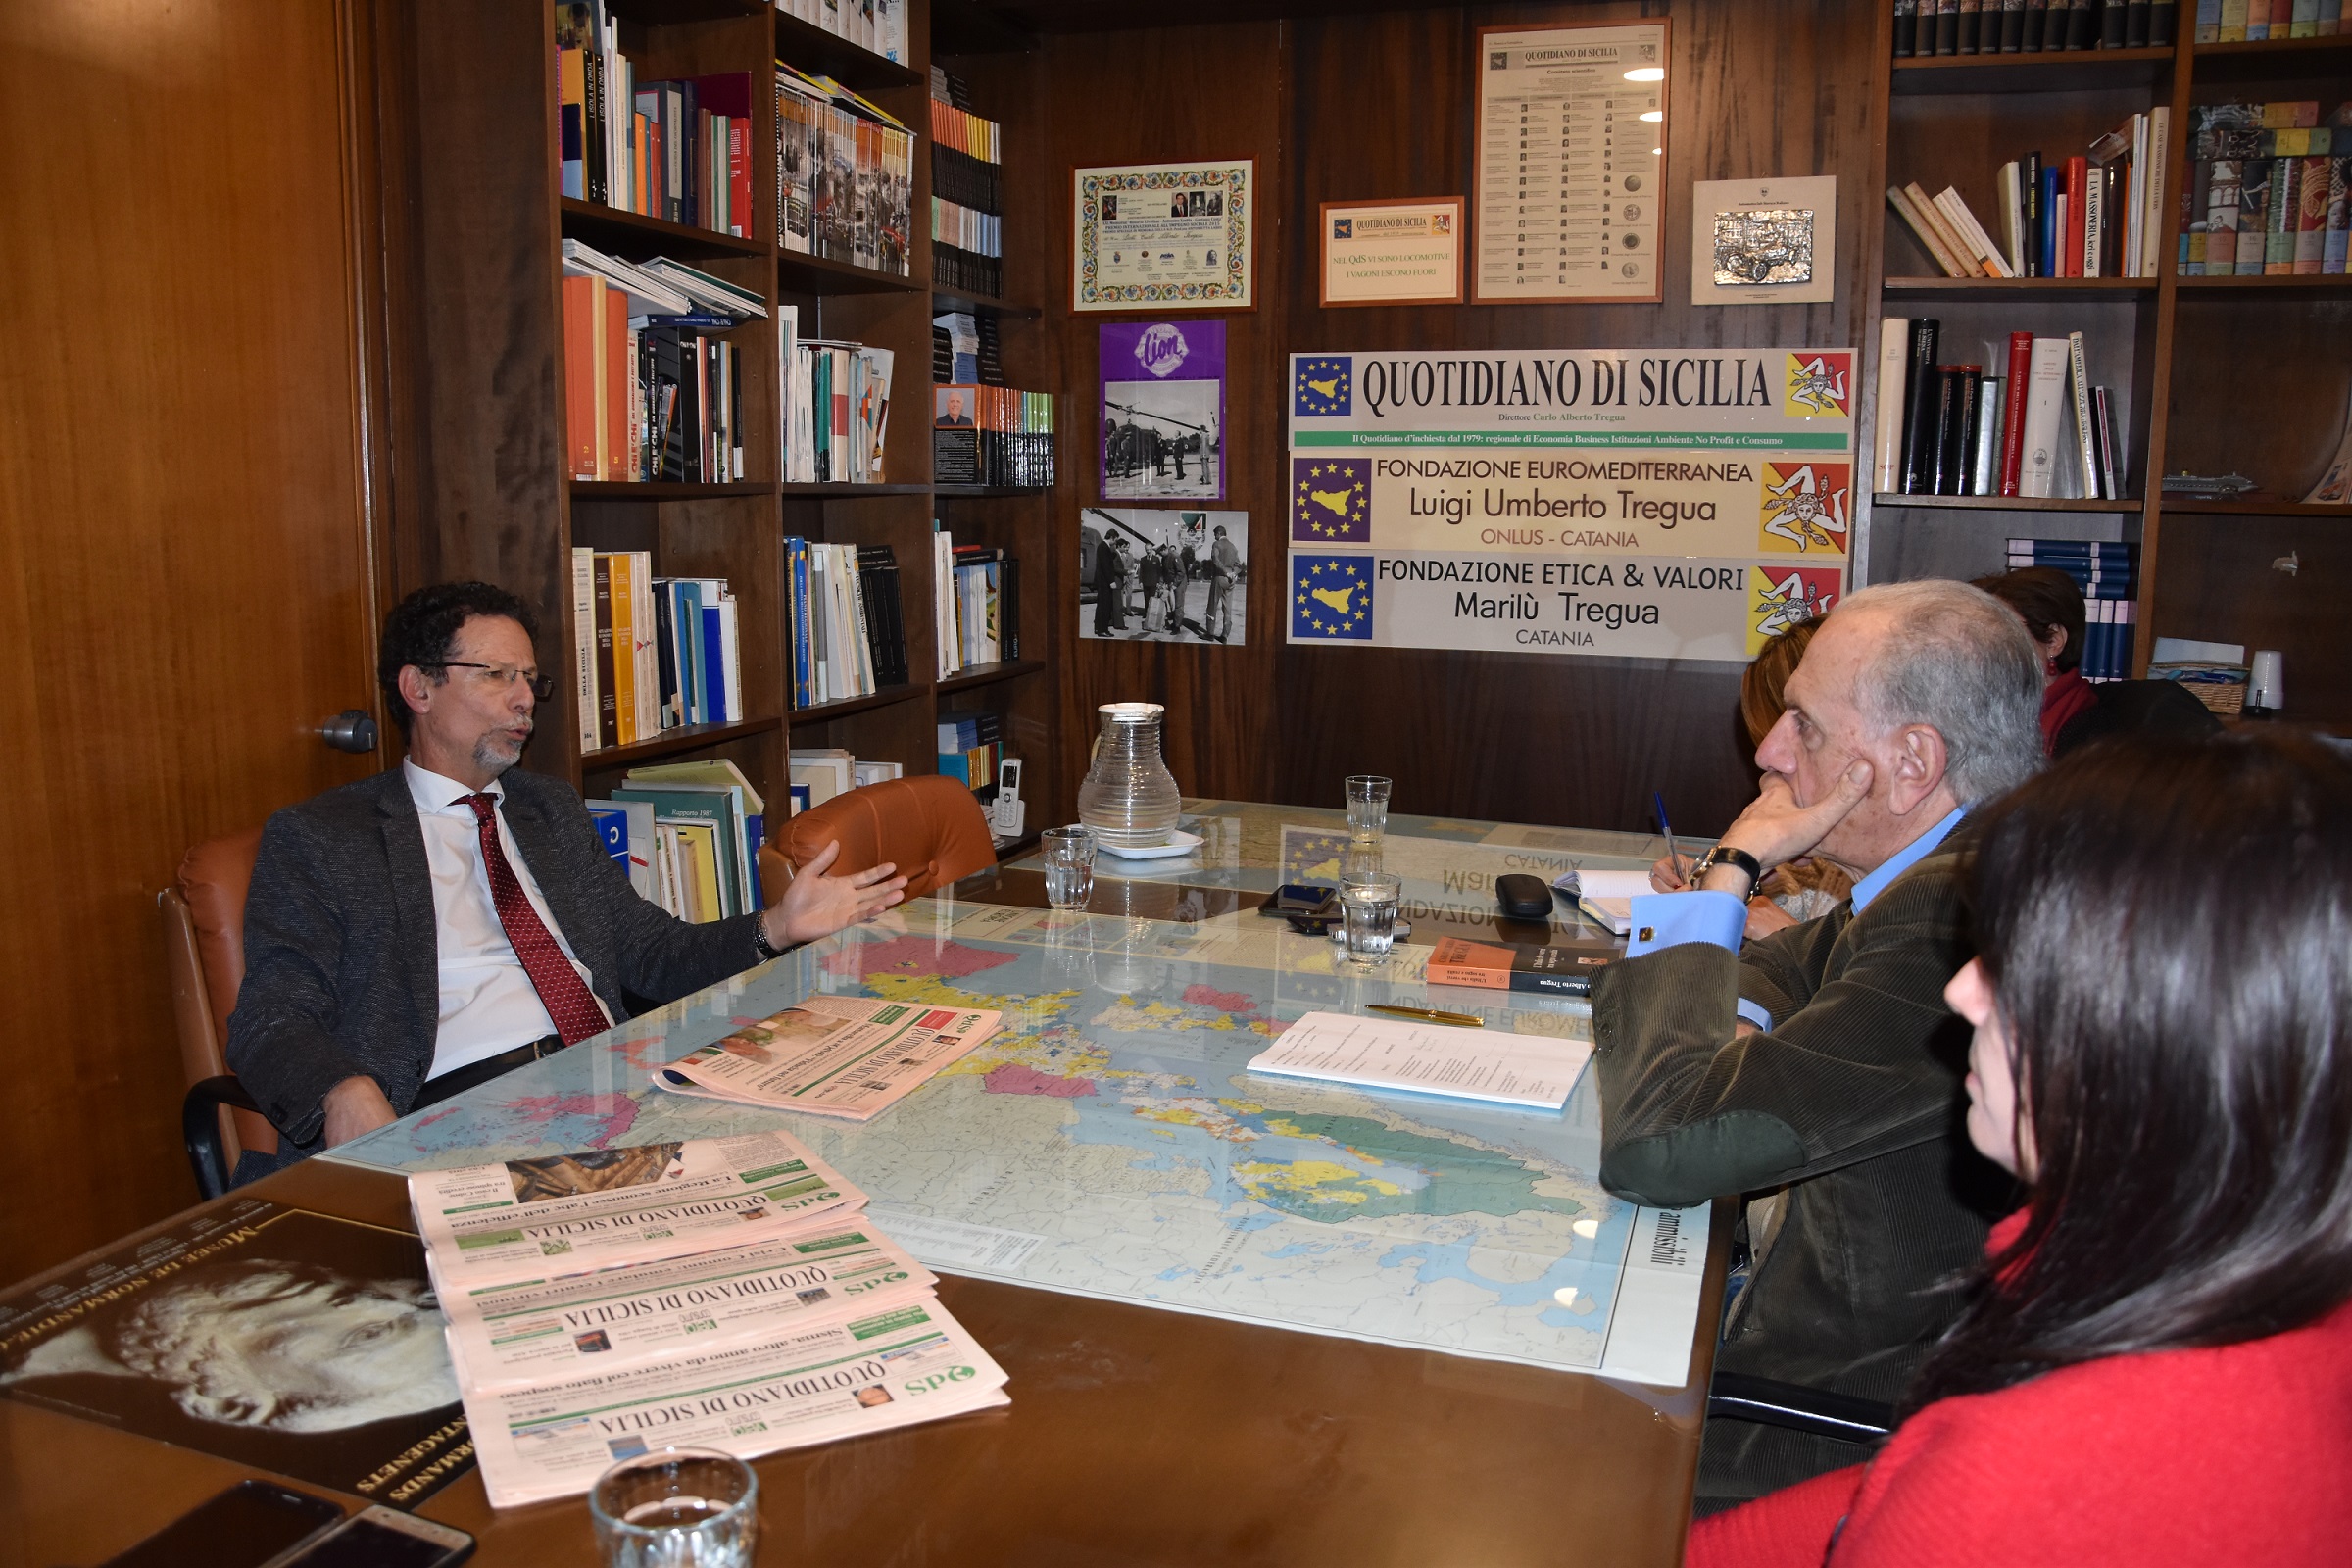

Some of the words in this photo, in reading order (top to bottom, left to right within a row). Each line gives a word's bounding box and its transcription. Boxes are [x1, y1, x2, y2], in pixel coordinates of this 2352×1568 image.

[1525, 49, 1576, 62] QUOTIDIANO
[1577, 48, 1588, 59] DI
[1589, 47, 1618, 58] SICILIA
[2089, 180, 2098, 191] LA
[1356, 219, 1396, 230] QUOTIDIANO
[1396, 218, 1403, 227] DI
[1404, 217, 1427, 226] SICILIA
[2087, 193, 2098, 240] MASSONERIA,
[1348, 255, 1367, 265] QdS
[1399, 253, 1449, 262] LOCOMOTIVE
[1350, 270, 1380, 278] VAGONI
[1381, 269, 1412, 277] ESCONO
[1363, 359, 1581, 417] QUOTIDIANO
[1591, 359, 1629, 406] DI
[1639, 358, 1772, 407] SICILIA
[1498, 413, 1531, 422] Direttore
[1533, 413, 1557, 422] Carlo
[1559, 413, 1592, 422] Alberto
[1593, 413, 1626, 423] Tregua
[1352, 434, 1359, 443] Il
[1360, 434, 1404, 444] Quotidiano
[1404, 434, 1446, 444] d'inchiesta
[1447, 434, 1461, 444] dal
[1462, 434, 1484, 444] 1979:
[1485, 435, 1522, 446] regionale
[1523, 434, 1532, 444] di
[1533, 435, 1573, 444] Economia
[1575, 434, 1609, 444] Business
[1611, 434, 1652, 444] Istituzioni
[1654, 434, 1694, 444] Ambiente
[1695, 435, 1708, 445] No
[1709, 435, 1734, 445] Profit
[1742, 435, 1783, 445] Consumo
[1377, 460, 1521, 479] FONDAZIONE
[1527, 461, 1754, 483] EUROMEDITERRANEA
[1409, 487, 1472, 525] Luigi
[1484, 488, 1607, 519] Umberto
[1617, 490, 1717, 530] Tregua
[1481, 529, 1544, 546] ONLUS
[1560, 530, 1640, 548] CATANIA
[1378, 559, 1534, 584] FONDAZIONE
[1542, 564, 1615, 587] ETICA
[1623, 564, 1645, 588] &
[1653, 566, 1744, 591] VALORI
[1455, 592, 1540, 621] Marilù
[1558, 592, 1660, 630] Tregua
[1515, 629, 1595, 647] CATANIA
[963, 1014, 982, 1030] QdS
[879, 1028, 935, 1068] QUOTIDIANO
[834, 1062, 876, 1085] SICILIA
[590, 1187, 651, 1205] sconosce
[653, 1175, 710, 1196] Regione
[639, 1195, 767, 1224] QUOTIDIANO
[780, 1191, 841, 1213] QdS
[528, 1217, 608, 1238] SICILIA
[612, 1213, 634, 1227] DI
[1651, 1211, 1682, 1265] ammissibili
[685, 1265, 827, 1305] QUOTIDIANO
[844, 1271, 909, 1296] QdS
[564, 1297, 654, 1328] SICILIA
[656, 1292, 683, 1311] DI
[790, 1324, 844, 1346] Sisma,
[733, 1359, 887, 1412] QUOTIDIANO
[905, 1365, 976, 1396] QdS
[696, 1393, 726, 1414] DI
[597, 1401, 695, 1437] SICILIA
[356, 1414, 468, 1494] NTAGENETS
